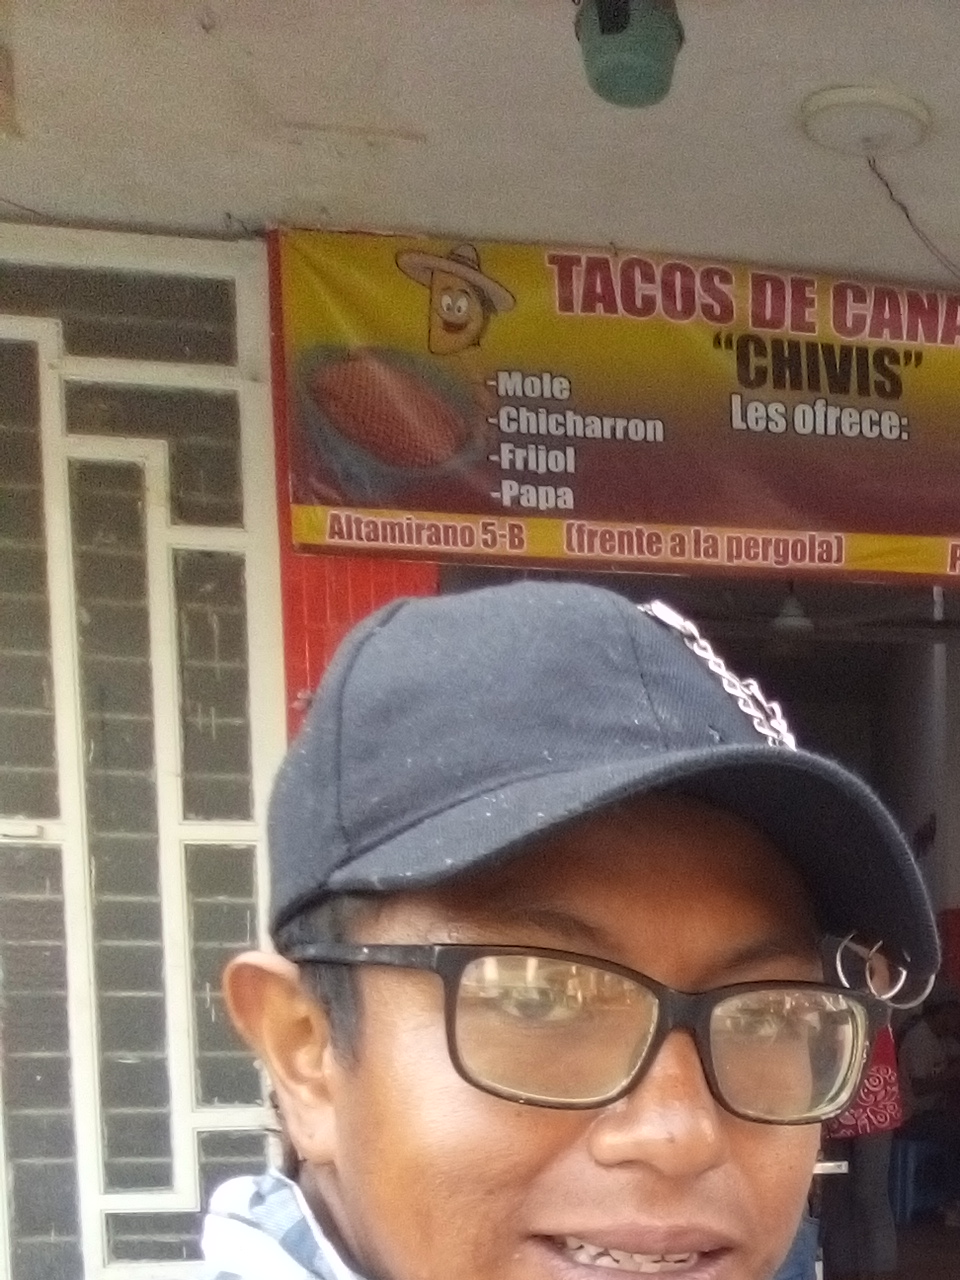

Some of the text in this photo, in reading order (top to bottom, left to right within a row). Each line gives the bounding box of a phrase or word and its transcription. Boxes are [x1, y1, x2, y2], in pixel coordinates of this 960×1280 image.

[546, 254, 736, 326] TACOS
[749, 272, 818, 336] DE
[713, 330, 924, 400] "CHIVIS"
[487, 405, 666, 442] -Chicharron
[731, 393, 909, 441] Les ofrece:
[490, 479, 575, 511] -Papa
[327, 509, 527, 552] Altamirano 5-B
[564, 520, 844, 568] (frente a la pergola)
